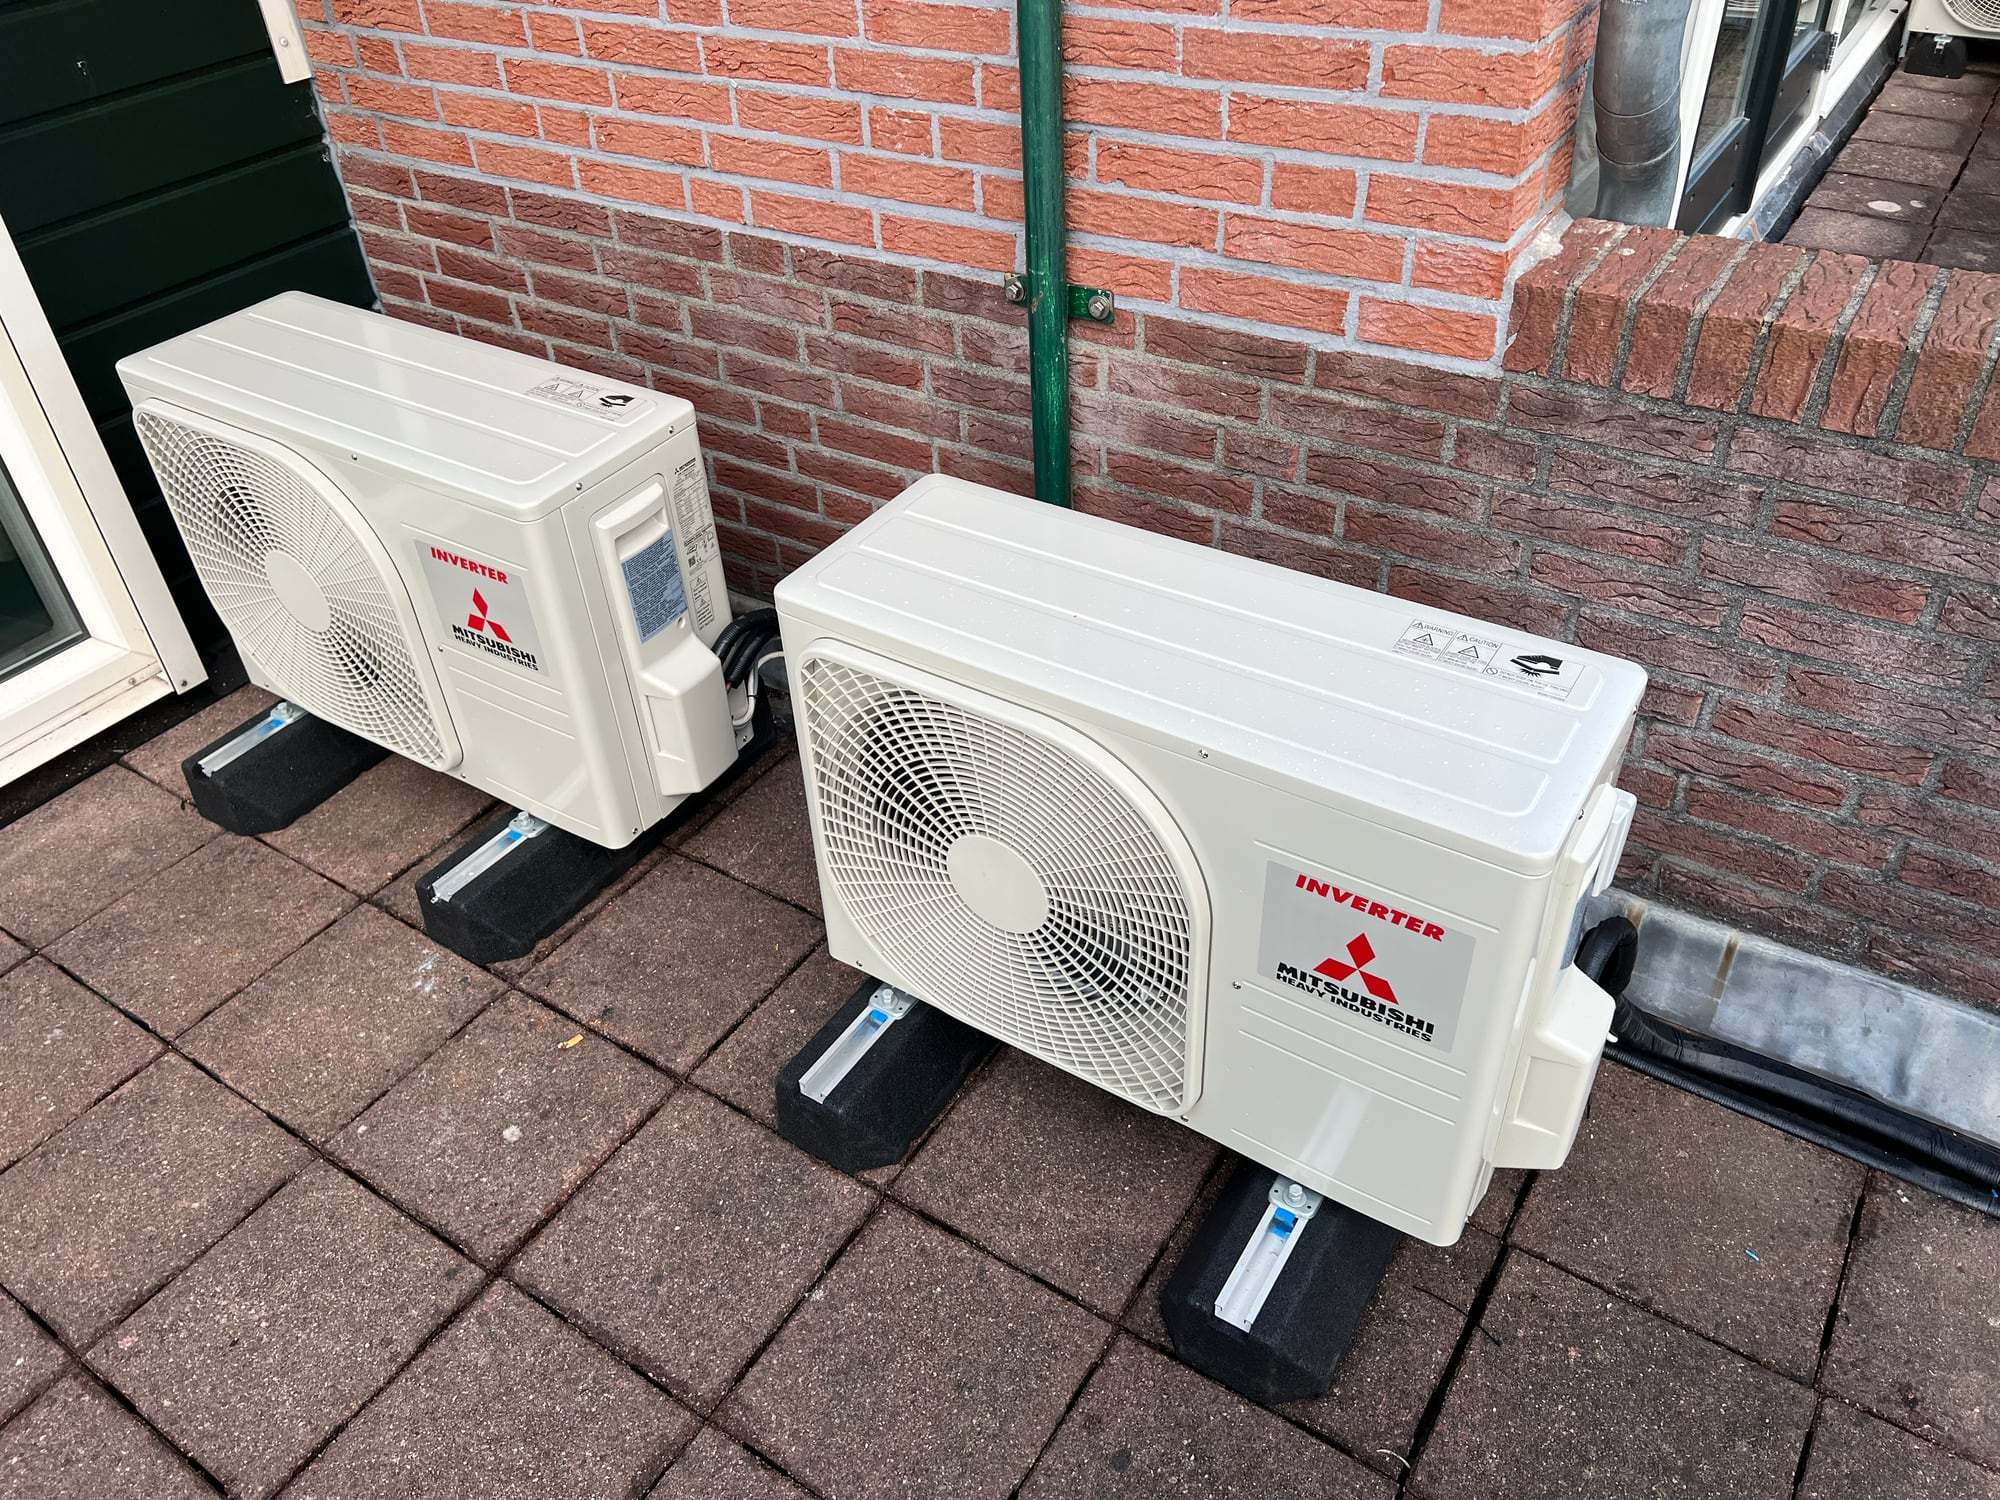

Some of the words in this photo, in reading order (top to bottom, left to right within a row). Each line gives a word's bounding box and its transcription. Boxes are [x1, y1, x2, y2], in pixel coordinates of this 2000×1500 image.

[430, 547, 508, 584] INVERTER
[452, 624, 537, 664] MITSUBISHI
[1423, 624, 1454, 637] WARNING
[1469, 636, 1499, 649] CAUTION
[455, 634, 481, 649] HEAVY
[484, 645, 539, 671] INDUSTRIES
[1295, 874, 1446, 942] INVERTER
[1276, 973, 1326, 998] HEAVY
[1330, 995, 1432, 1042] INDUSTRIES
[1277, 962, 1435, 1035] MITSUBISHI
